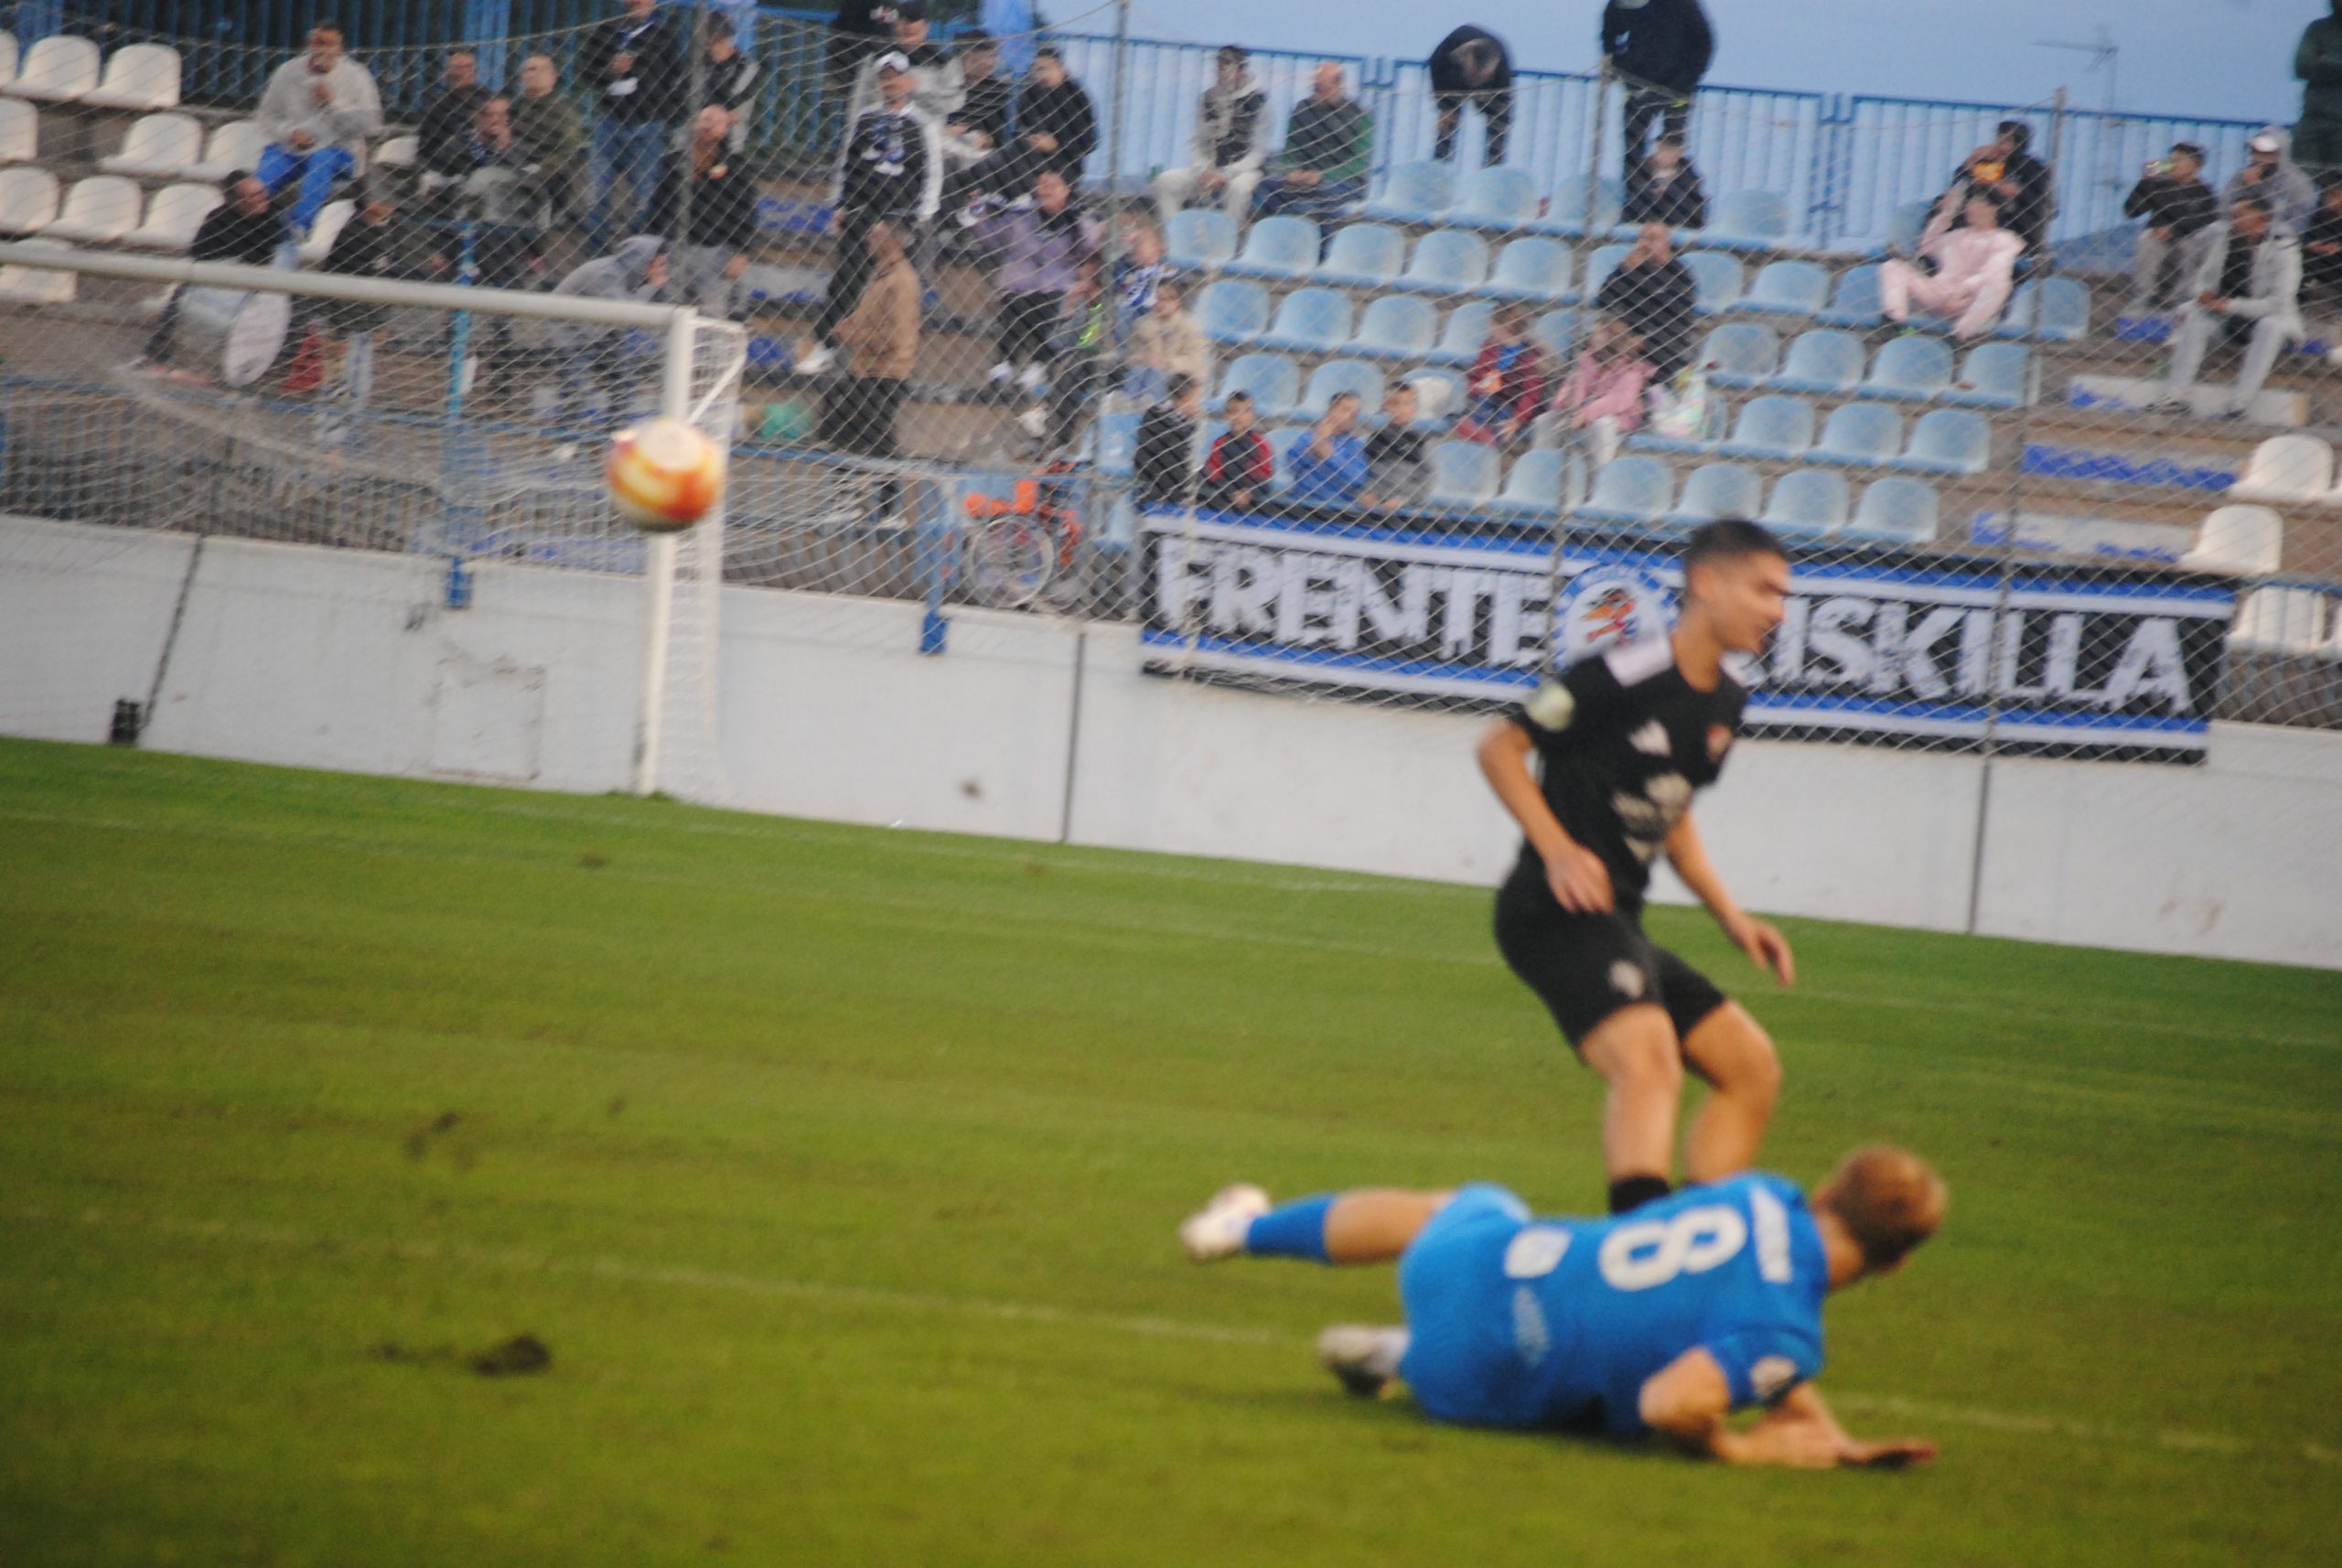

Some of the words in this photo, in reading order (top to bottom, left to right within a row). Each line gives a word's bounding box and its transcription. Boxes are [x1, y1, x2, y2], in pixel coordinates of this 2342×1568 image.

[1155, 535, 1551, 668] FRENTE
[1733, 595, 2191, 713] ISKILLA
[1599, 1205, 1746, 1291] 8
